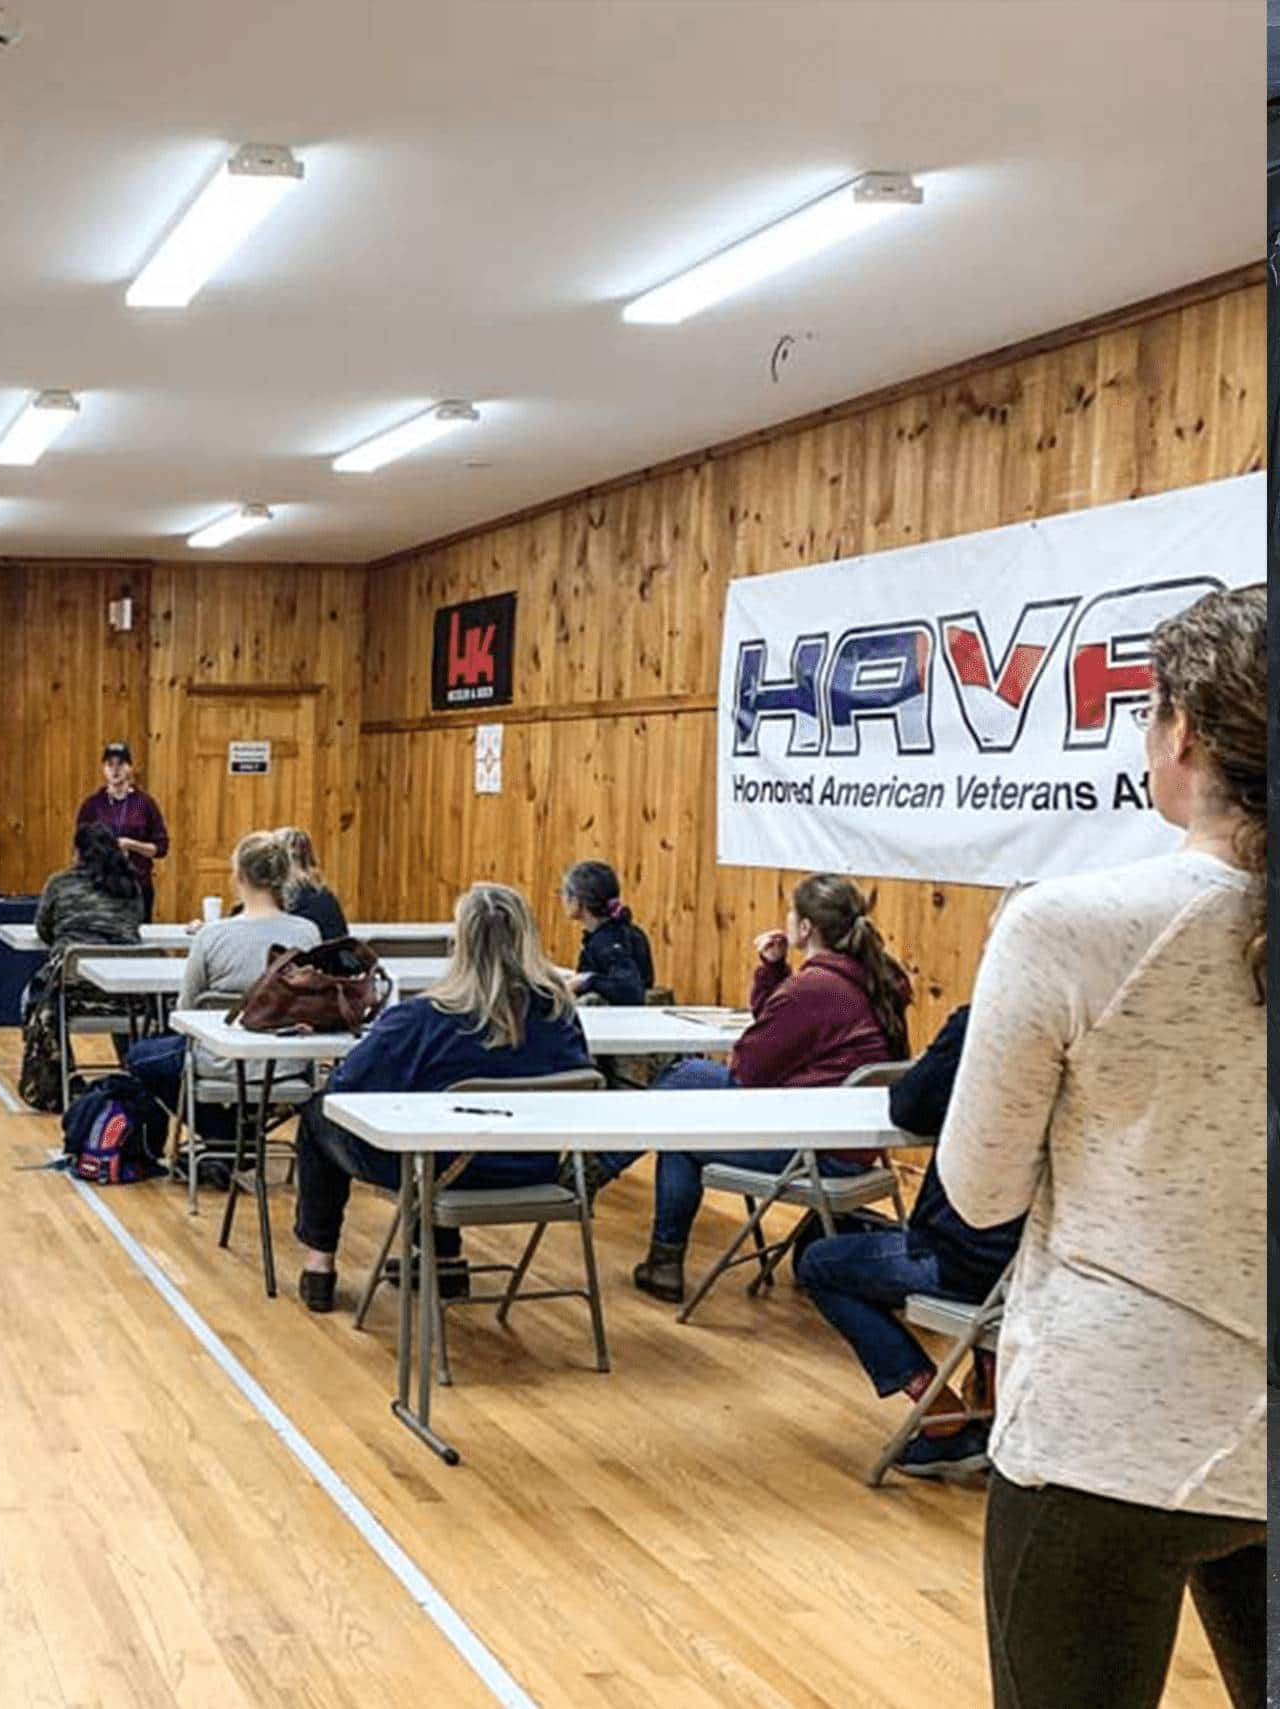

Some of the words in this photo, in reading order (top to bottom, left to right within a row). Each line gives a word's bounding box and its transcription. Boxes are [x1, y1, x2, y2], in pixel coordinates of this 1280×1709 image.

[732, 774, 815, 805] Honored
[819, 775, 945, 809] American
[956, 774, 1098, 811] Veterans
